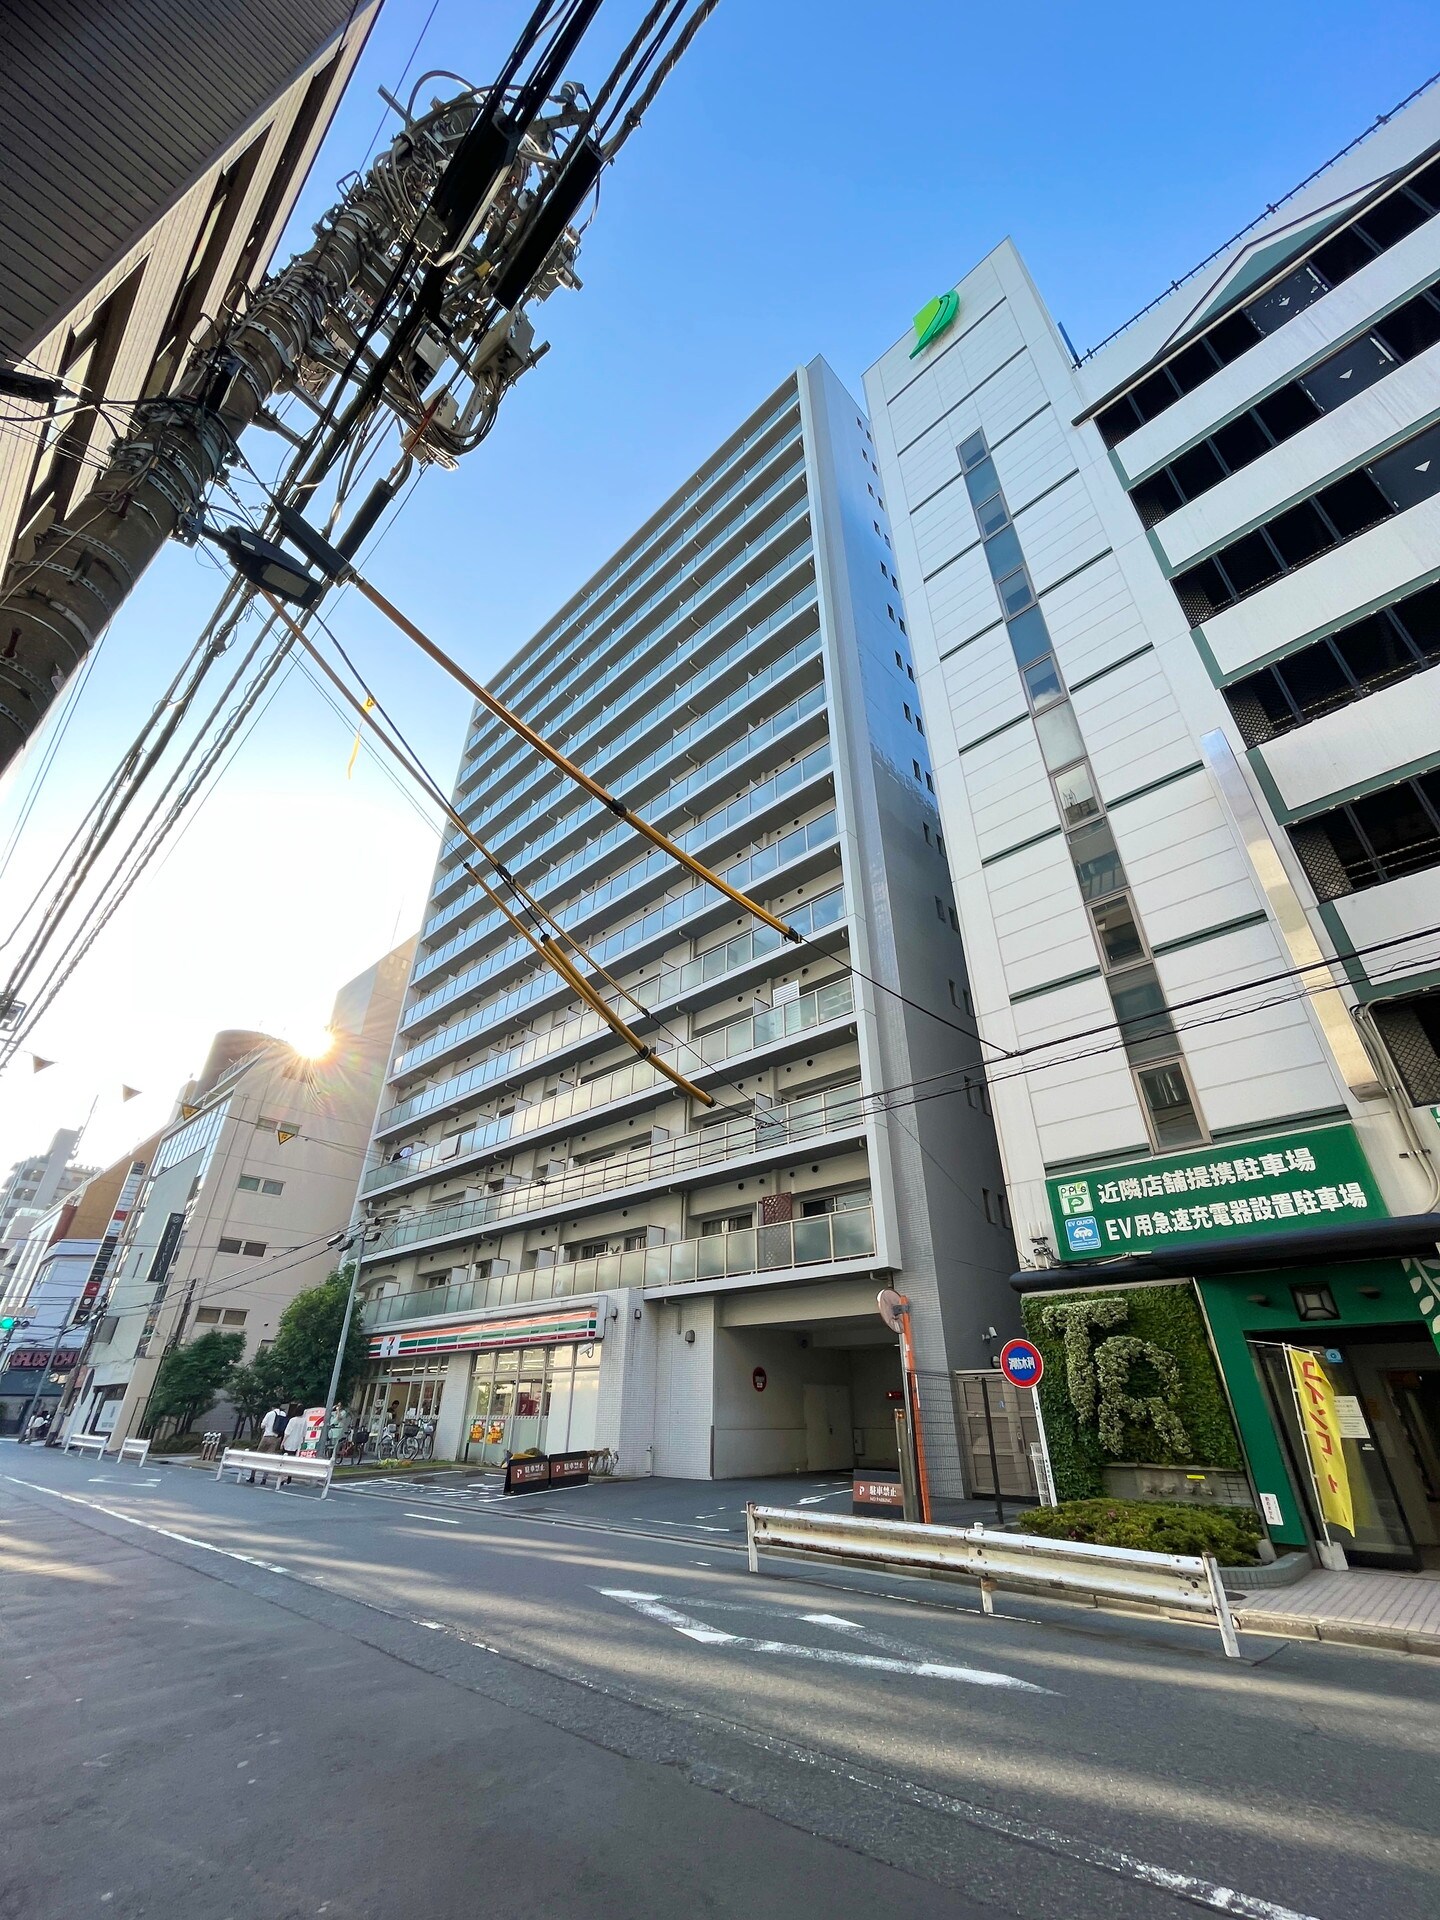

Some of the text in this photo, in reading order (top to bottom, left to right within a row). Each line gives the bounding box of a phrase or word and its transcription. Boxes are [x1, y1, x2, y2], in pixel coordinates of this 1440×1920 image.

[1097, 1147, 1316, 1205] 近隣店舗提携駐車場
[1076, 1218, 1094, 1226] QUICK
[1105, 1182, 1368, 1242] EV用急速充電器設置駐車場
[869, 1485, 897, 1497] 駐車禁止
